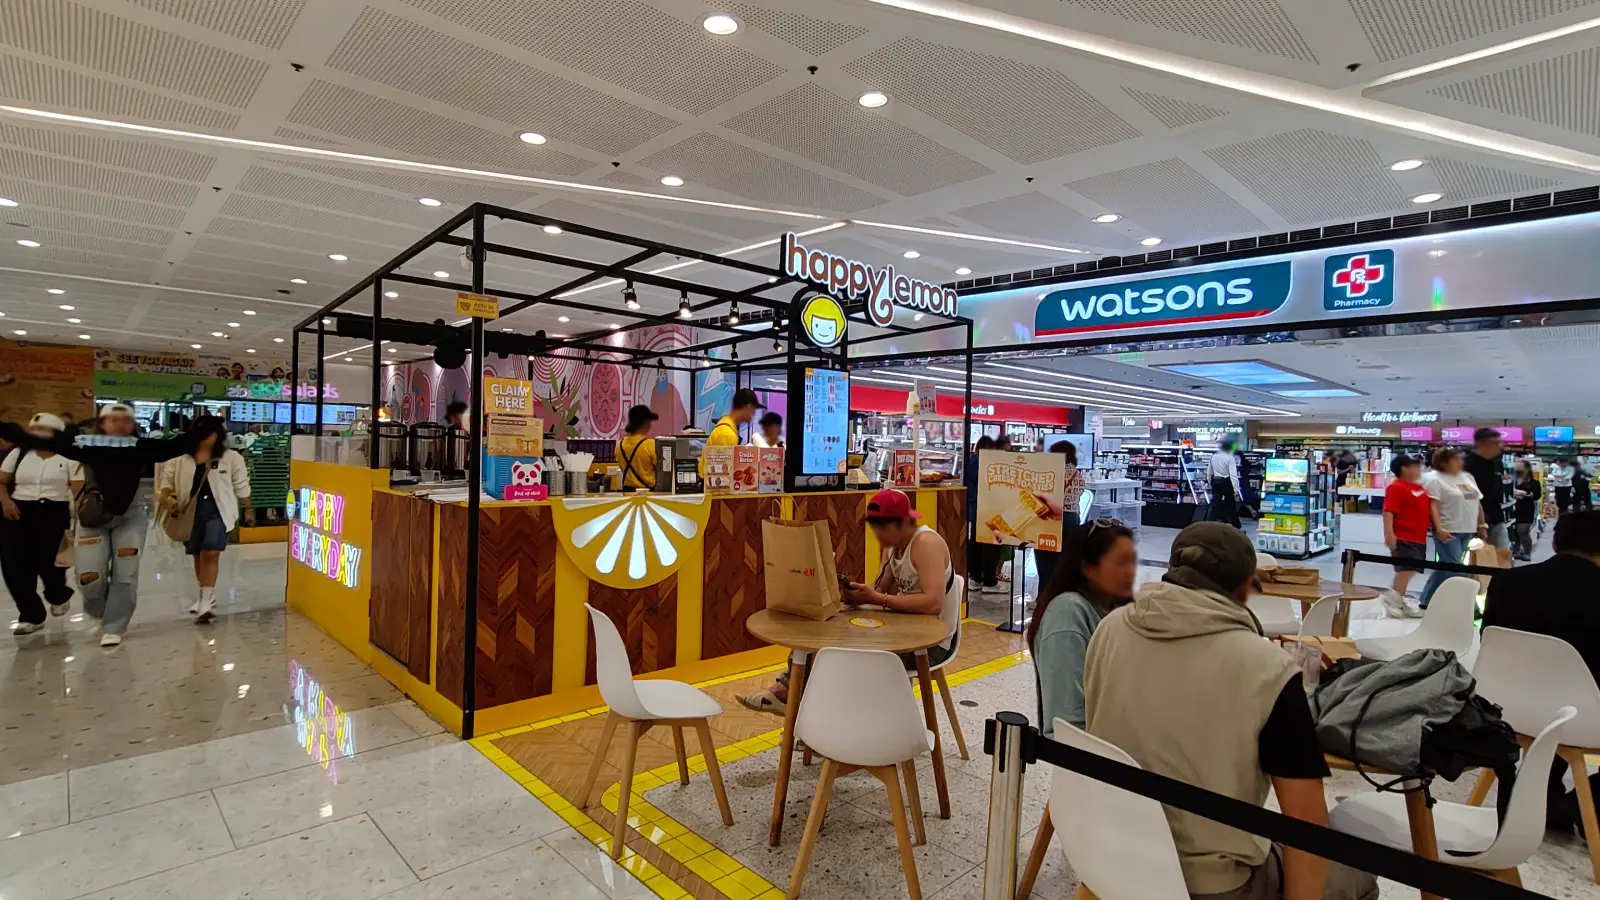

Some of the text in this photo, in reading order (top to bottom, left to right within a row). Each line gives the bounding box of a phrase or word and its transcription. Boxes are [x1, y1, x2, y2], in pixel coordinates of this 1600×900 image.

[1061, 277, 1253, 321] watsons
[1334, 298, 1381, 307] Pharmacy
[490, 383, 528, 397] CLAIM
[495, 396, 525, 409] HERE
[1363, 412, 1392, 422] Health
[1400, 412, 1438, 422] Wellness
[1347, 425, 1381, 437] Pharmacy
[987, 463, 1055, 484] STRETCHED
[1017, 478, 1054, 491] TOASTIES
[300, 487, 344, 535] HAPPY
[291, 523, 362, 588] EVERYDAY
